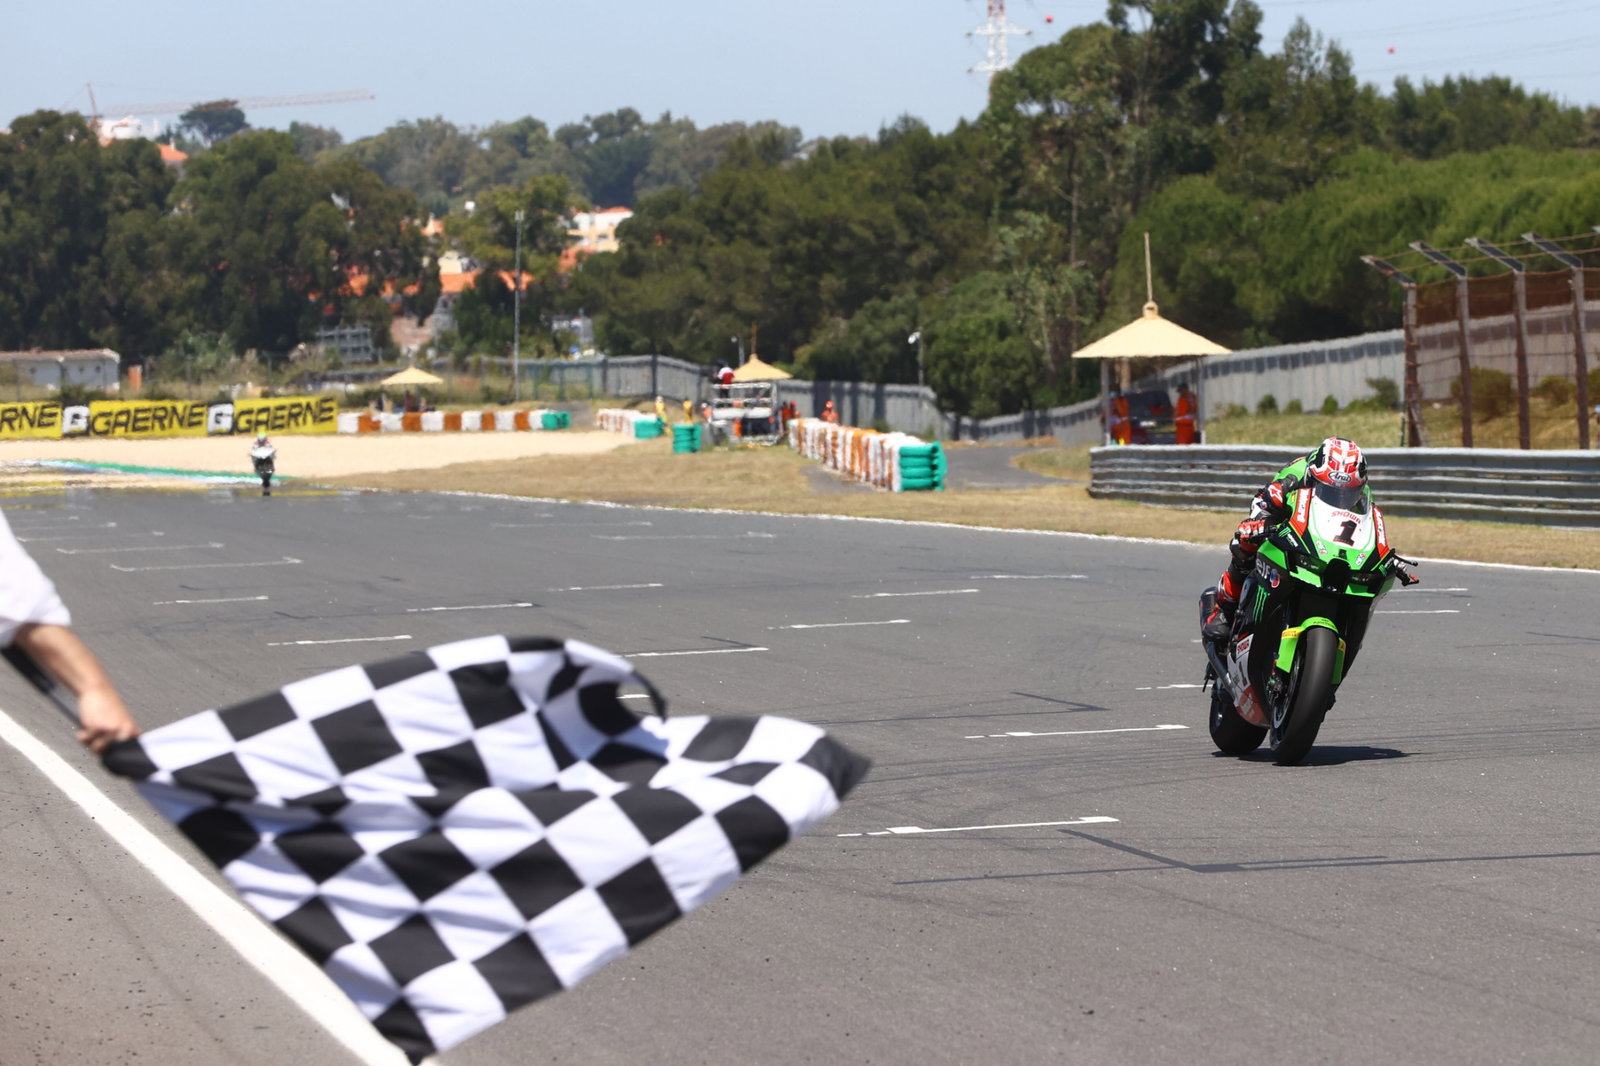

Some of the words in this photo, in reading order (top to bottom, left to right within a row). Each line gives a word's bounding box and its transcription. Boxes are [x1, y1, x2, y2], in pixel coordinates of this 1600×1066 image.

[91, 404, 206, 436] GAERNE
[234, 398, 335, 433] GAERNE
[1332, 472, 1349, 482] Arai
[1333, 520, 1358, 546] 1
[1256, 558, 1271, 579] elf
